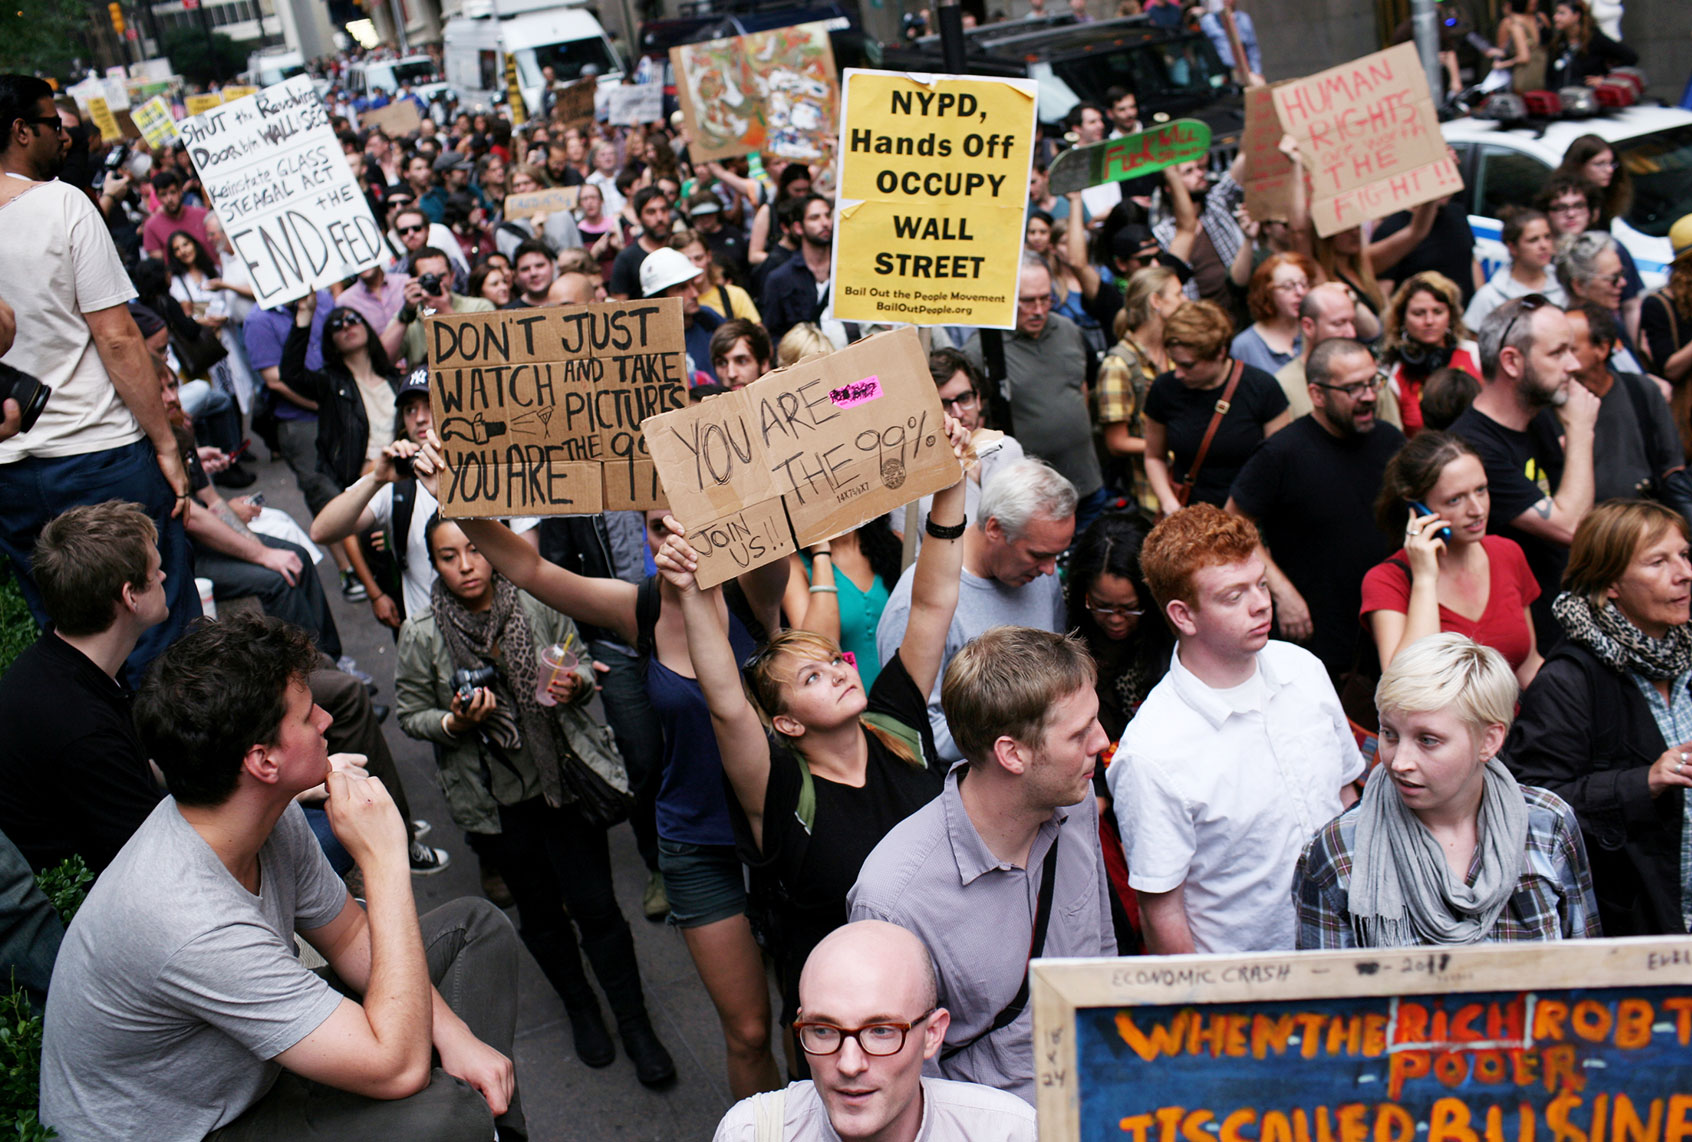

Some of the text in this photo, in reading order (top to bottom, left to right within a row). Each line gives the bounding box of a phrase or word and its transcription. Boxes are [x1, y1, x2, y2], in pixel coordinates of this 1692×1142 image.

[891, 90, 987, 124] NYPD,
[1280, 58, 1394, 127] HUMAN
[1308, 88, 1418, 152] RIGHTS
[277, 146, 329, 176] GLASS
[851, 128, 1015, 159] Hands Off
[876, 170, 1006, 197] OCCUPY
[1324, 144, 1398, 190] THE
[220, 166, 335, 223] STEAGAL ACT
[893, 215, 974, 241] WALL
[232, 211, 382, 299] END FED
[874, 252, 985, 279] STREET
[845, 286, 1006, 303] Bail Out the People Movement
[876, 301, 973, 316] BailOutPeople.org
[433, 307, 659, 364] DON'T JUST
[435, 352, 681, 413] WATCH AND TAKE
[670, 378, 841, 493] YOU ARE
[771, 410, 937, 506] THE 99%
[444, 450, 500, 504] YOU
[506, 444, 573, 507] ARE
[561, 434, 603, 462] THE
[688, 512, 751, 557] JOIN
[1112, 968, 1217, 987] ECONOMIC
[1222, 964, 1291, 983] CRASH
[1395, 1001, 1523, 1044] RICH
